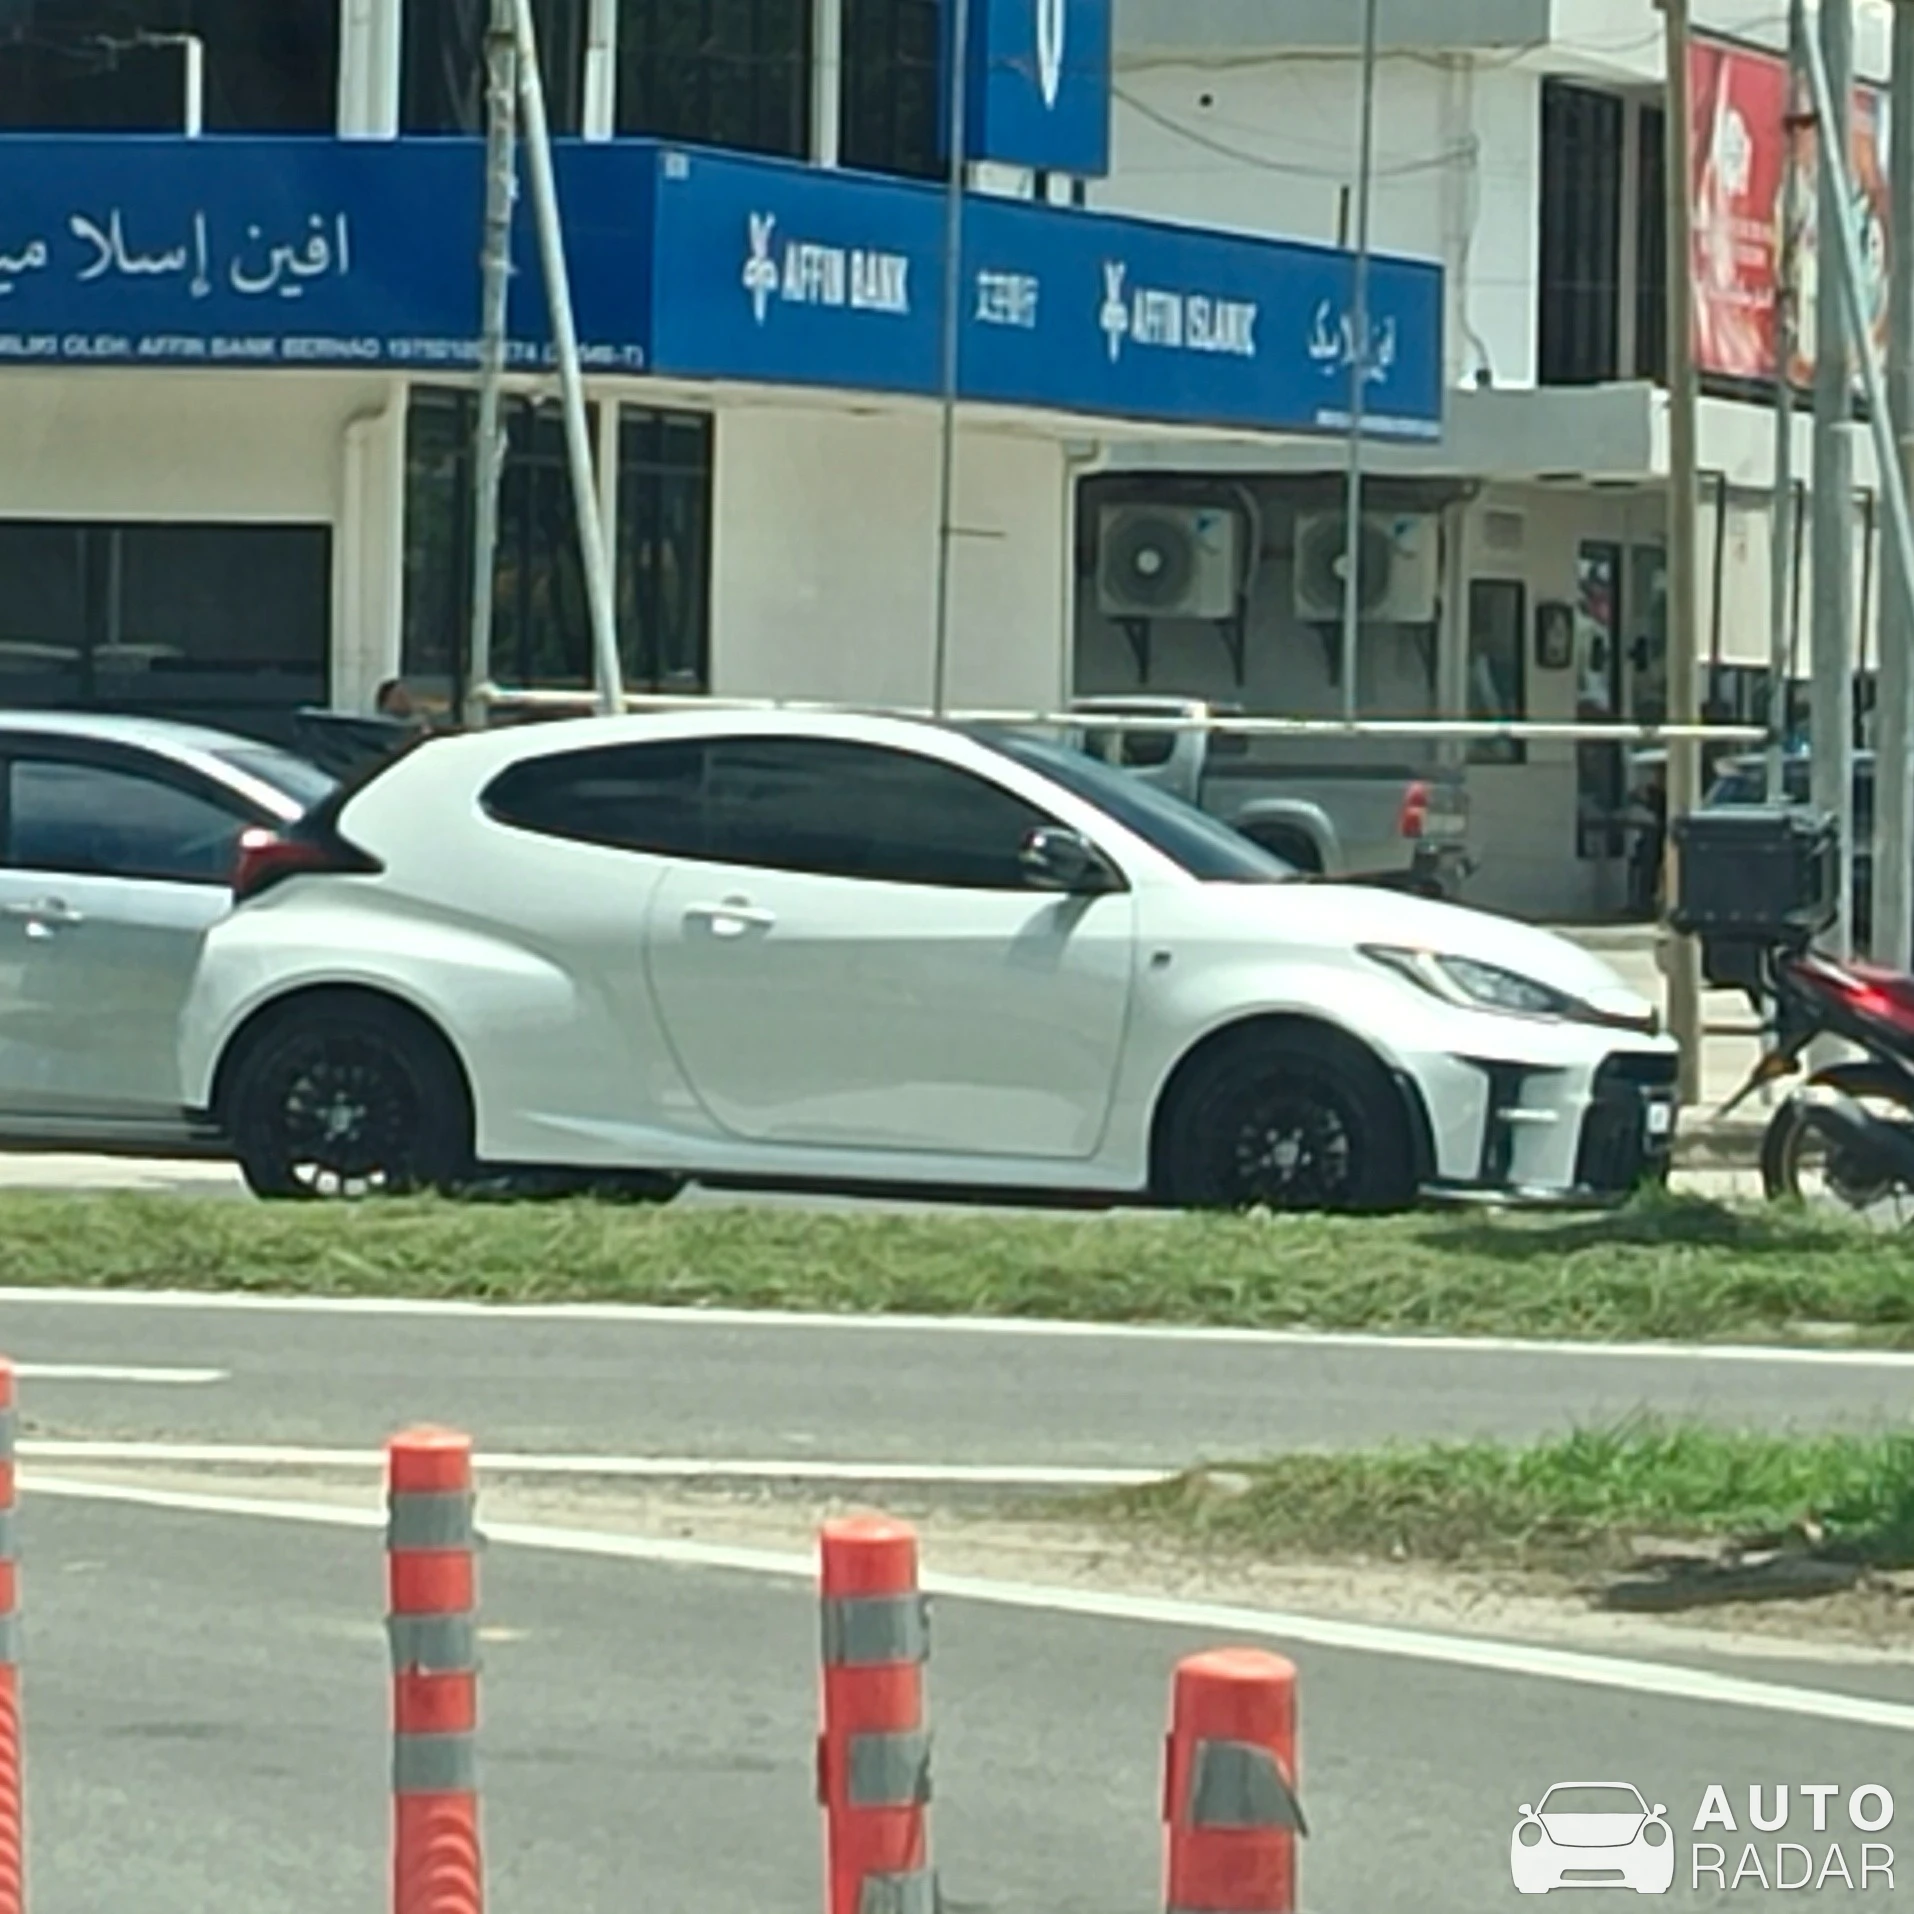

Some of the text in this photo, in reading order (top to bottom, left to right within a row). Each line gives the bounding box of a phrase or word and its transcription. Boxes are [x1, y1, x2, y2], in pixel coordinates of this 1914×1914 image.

[782, 241, 845, 304] AFFIN
[851, 249, 910, 314] BANK
[1132, 286, 1257, 358] AFFIN ISLAMIC
